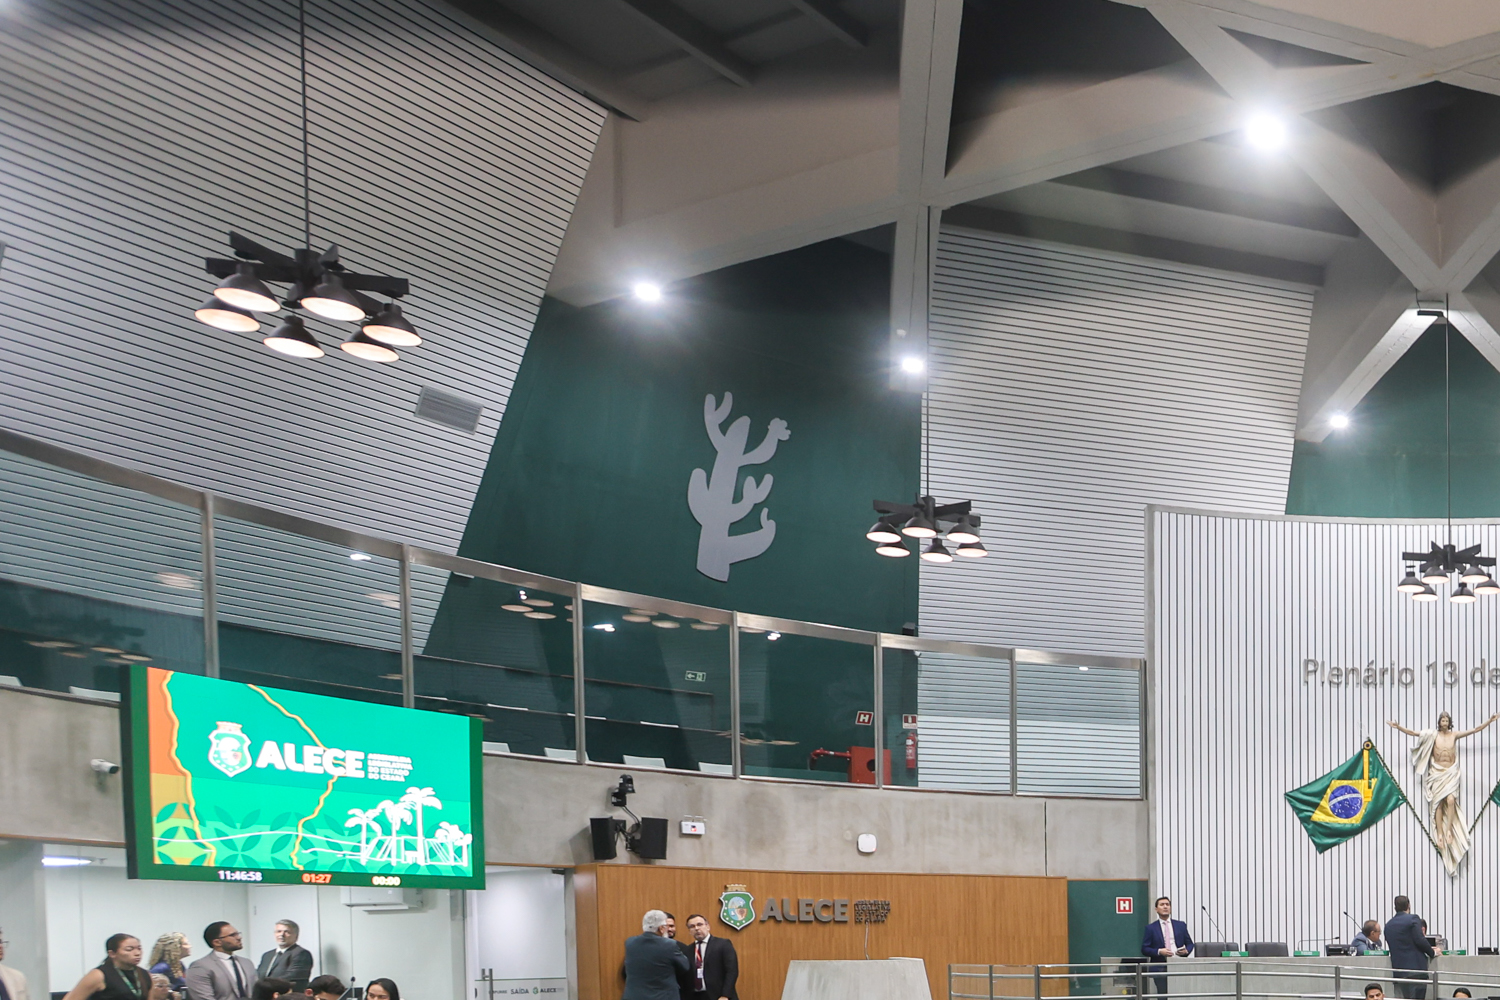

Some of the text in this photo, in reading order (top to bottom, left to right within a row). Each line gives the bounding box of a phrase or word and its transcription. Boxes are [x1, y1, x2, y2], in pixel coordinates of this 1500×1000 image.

[1302, 658, 1415, 687] Plenário
[1426, 660, 1459, 687] 13
[255, 740, 365, 778] ALECE
[218, 870, 263, 882] 11:46:58
[302, 873, 332, 884] 01:27
[371, 876, 401, 886] 00:00
[760, 897, 849, 923] ALECE
[1120, 900, 1129, 910] H
